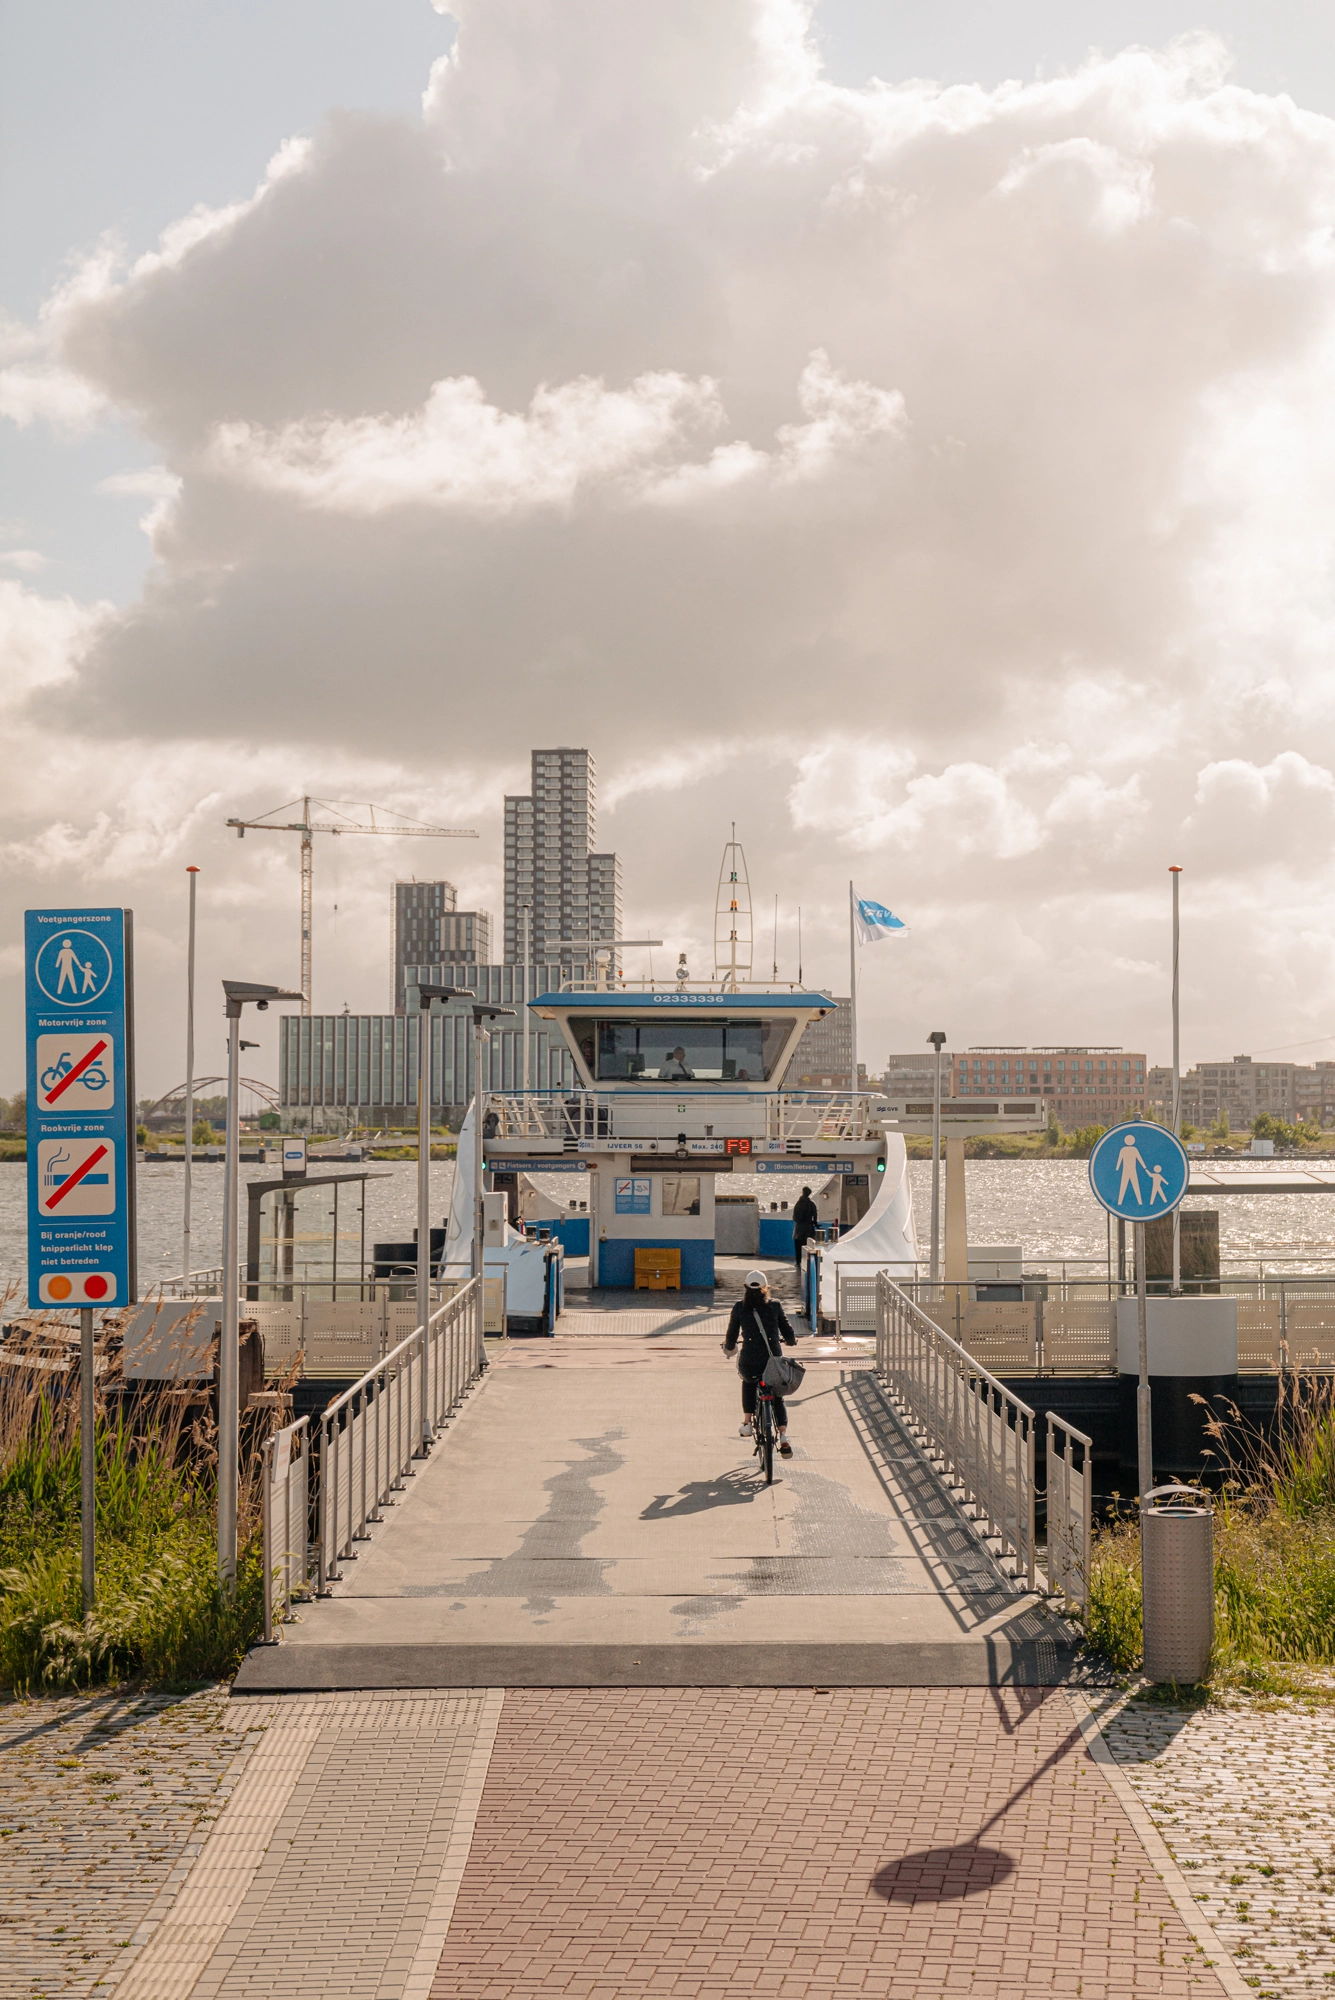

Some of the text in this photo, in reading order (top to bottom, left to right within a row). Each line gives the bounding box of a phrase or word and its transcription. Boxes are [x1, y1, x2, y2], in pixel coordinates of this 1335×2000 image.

[37, 915, 112, 924] Voetgangerszone
[653, 995, 724, 1003] 02333336
[38, 1019, 84, 1027] Motorvrije
[40, 1124, 82, 1133] Rookvrije
[537, 1162, 576, 1170] voetgangers
[40, 1230, 106, 1240] Bij oranje/rood
[40, 1243, 114, 1253] knipperlicht klep
[41, 1257, 100, 1266] niet betreden
